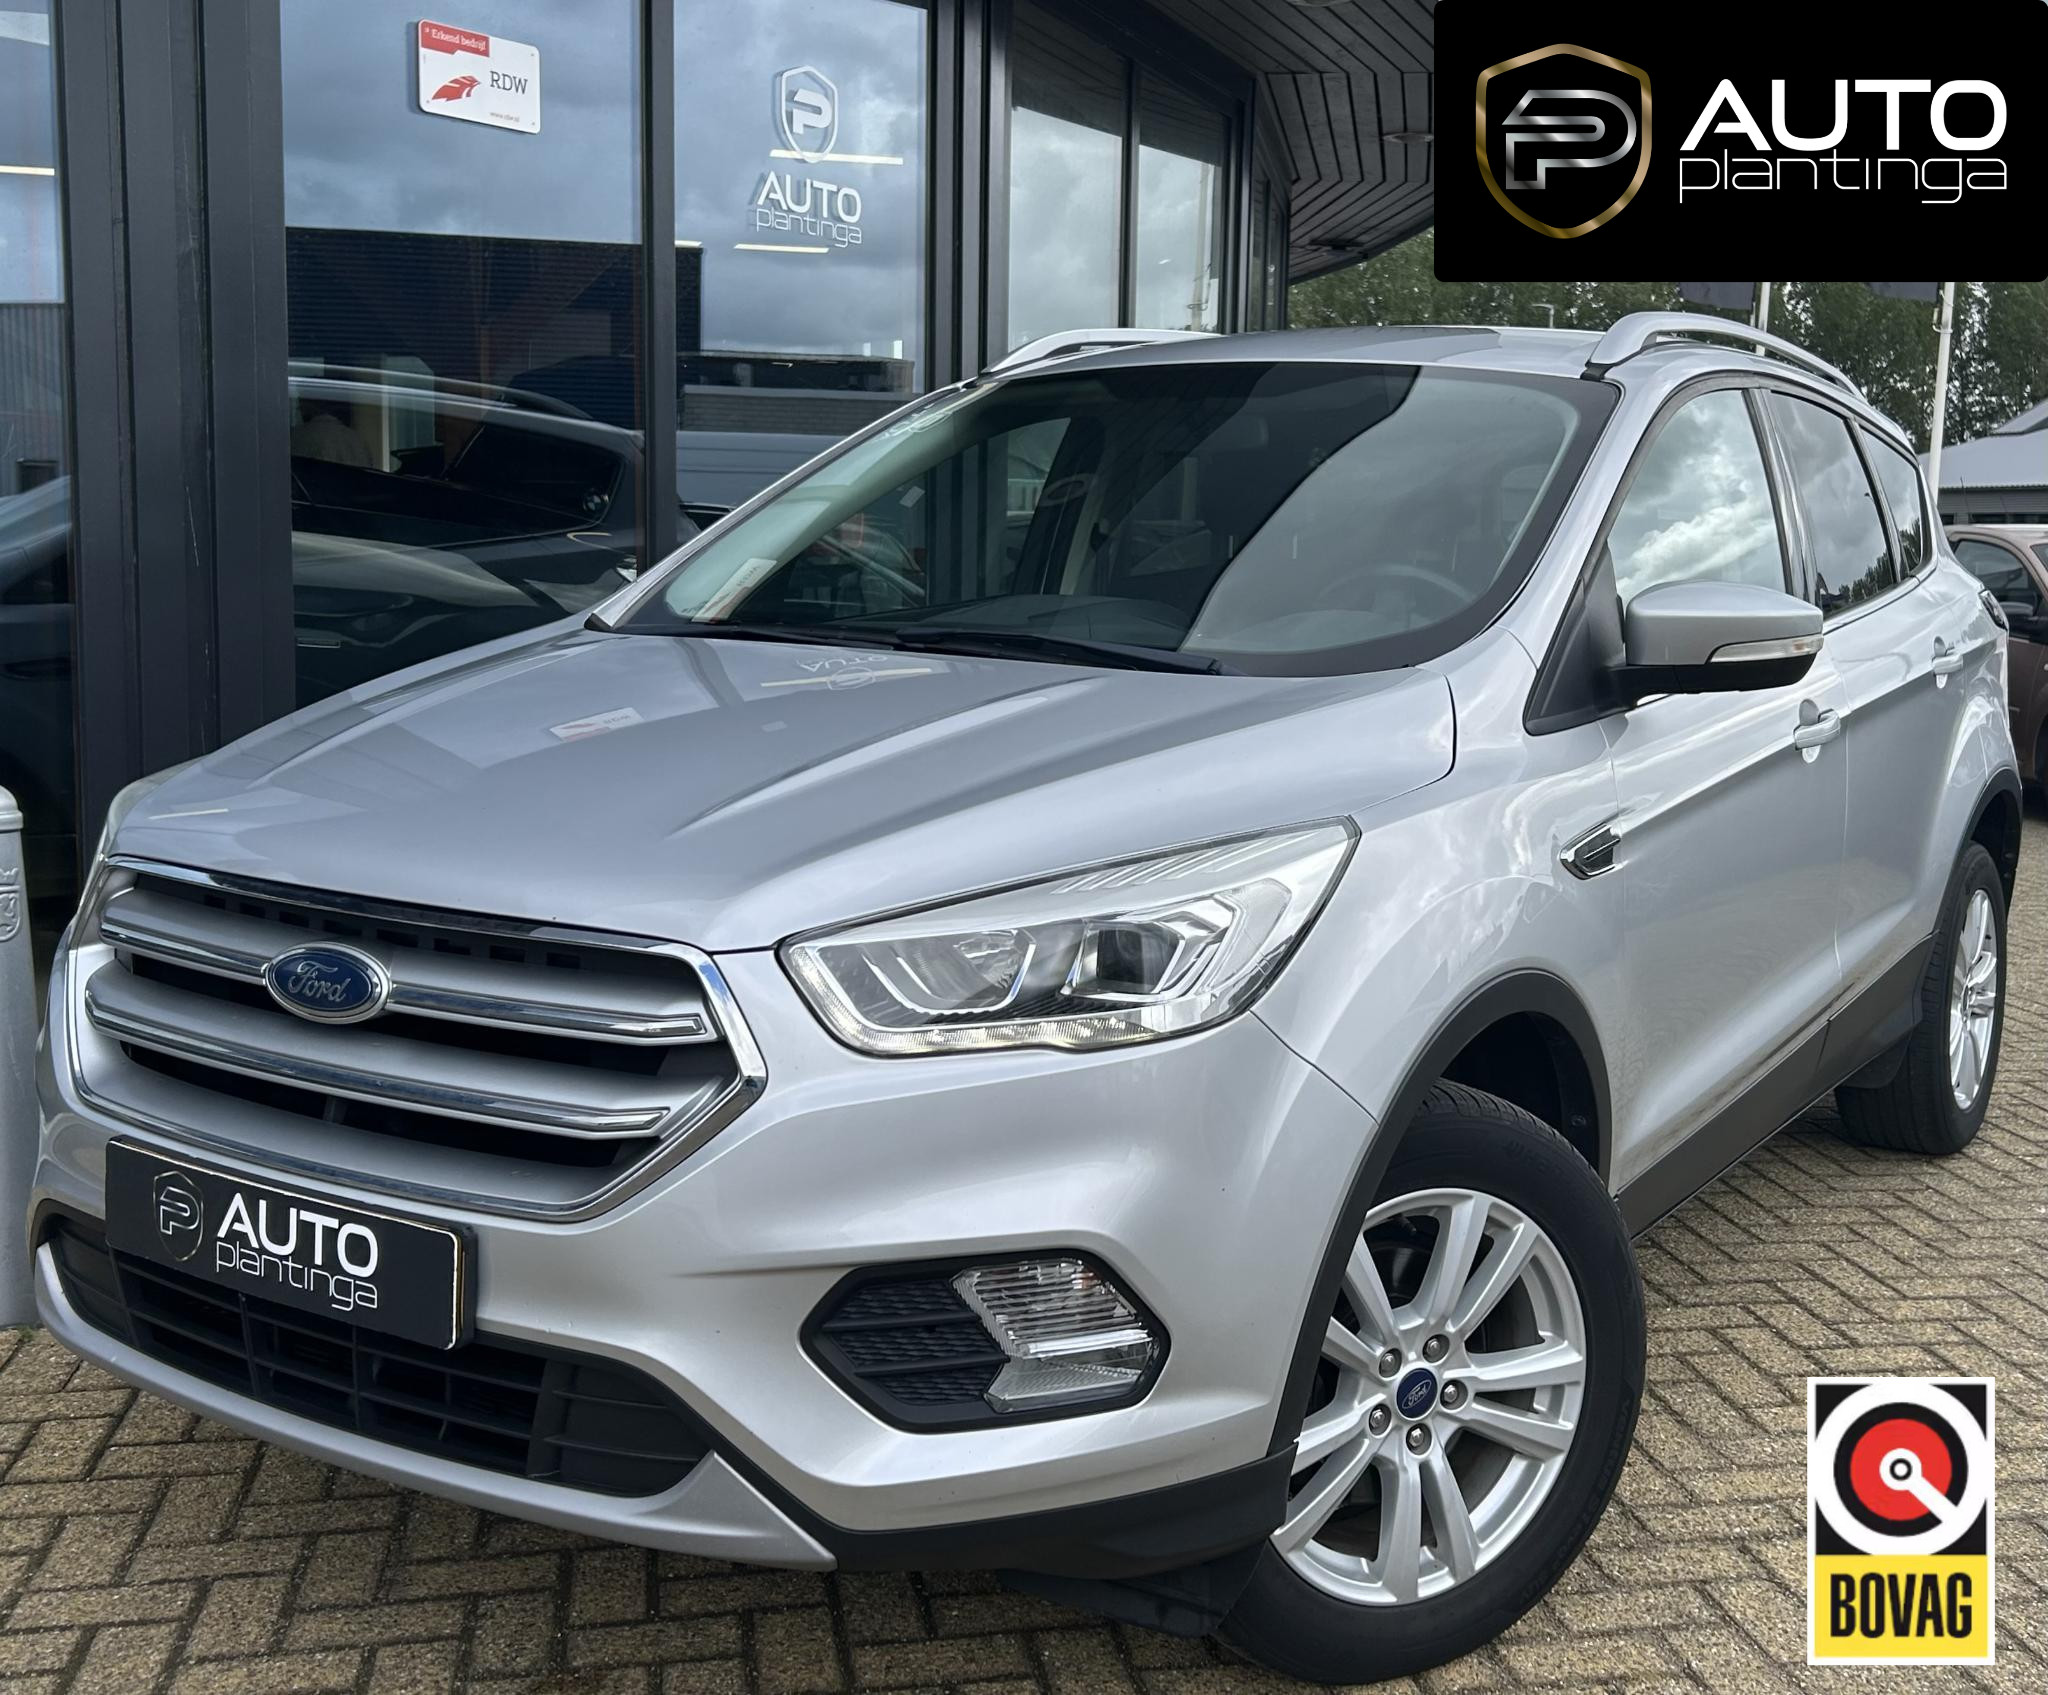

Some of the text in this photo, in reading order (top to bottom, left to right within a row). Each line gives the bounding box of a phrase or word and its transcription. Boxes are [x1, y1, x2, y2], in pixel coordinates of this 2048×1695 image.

[489, 70, 528, 95] RDW
[757, 171, 862, 224] AUTO
[756, 208, 862, 248] plantinga
[287, 960, 352, 1002] Ford
[217, 1192, 379, 1278] AUTO
[216, 1241, 379, 1312] plantinga
